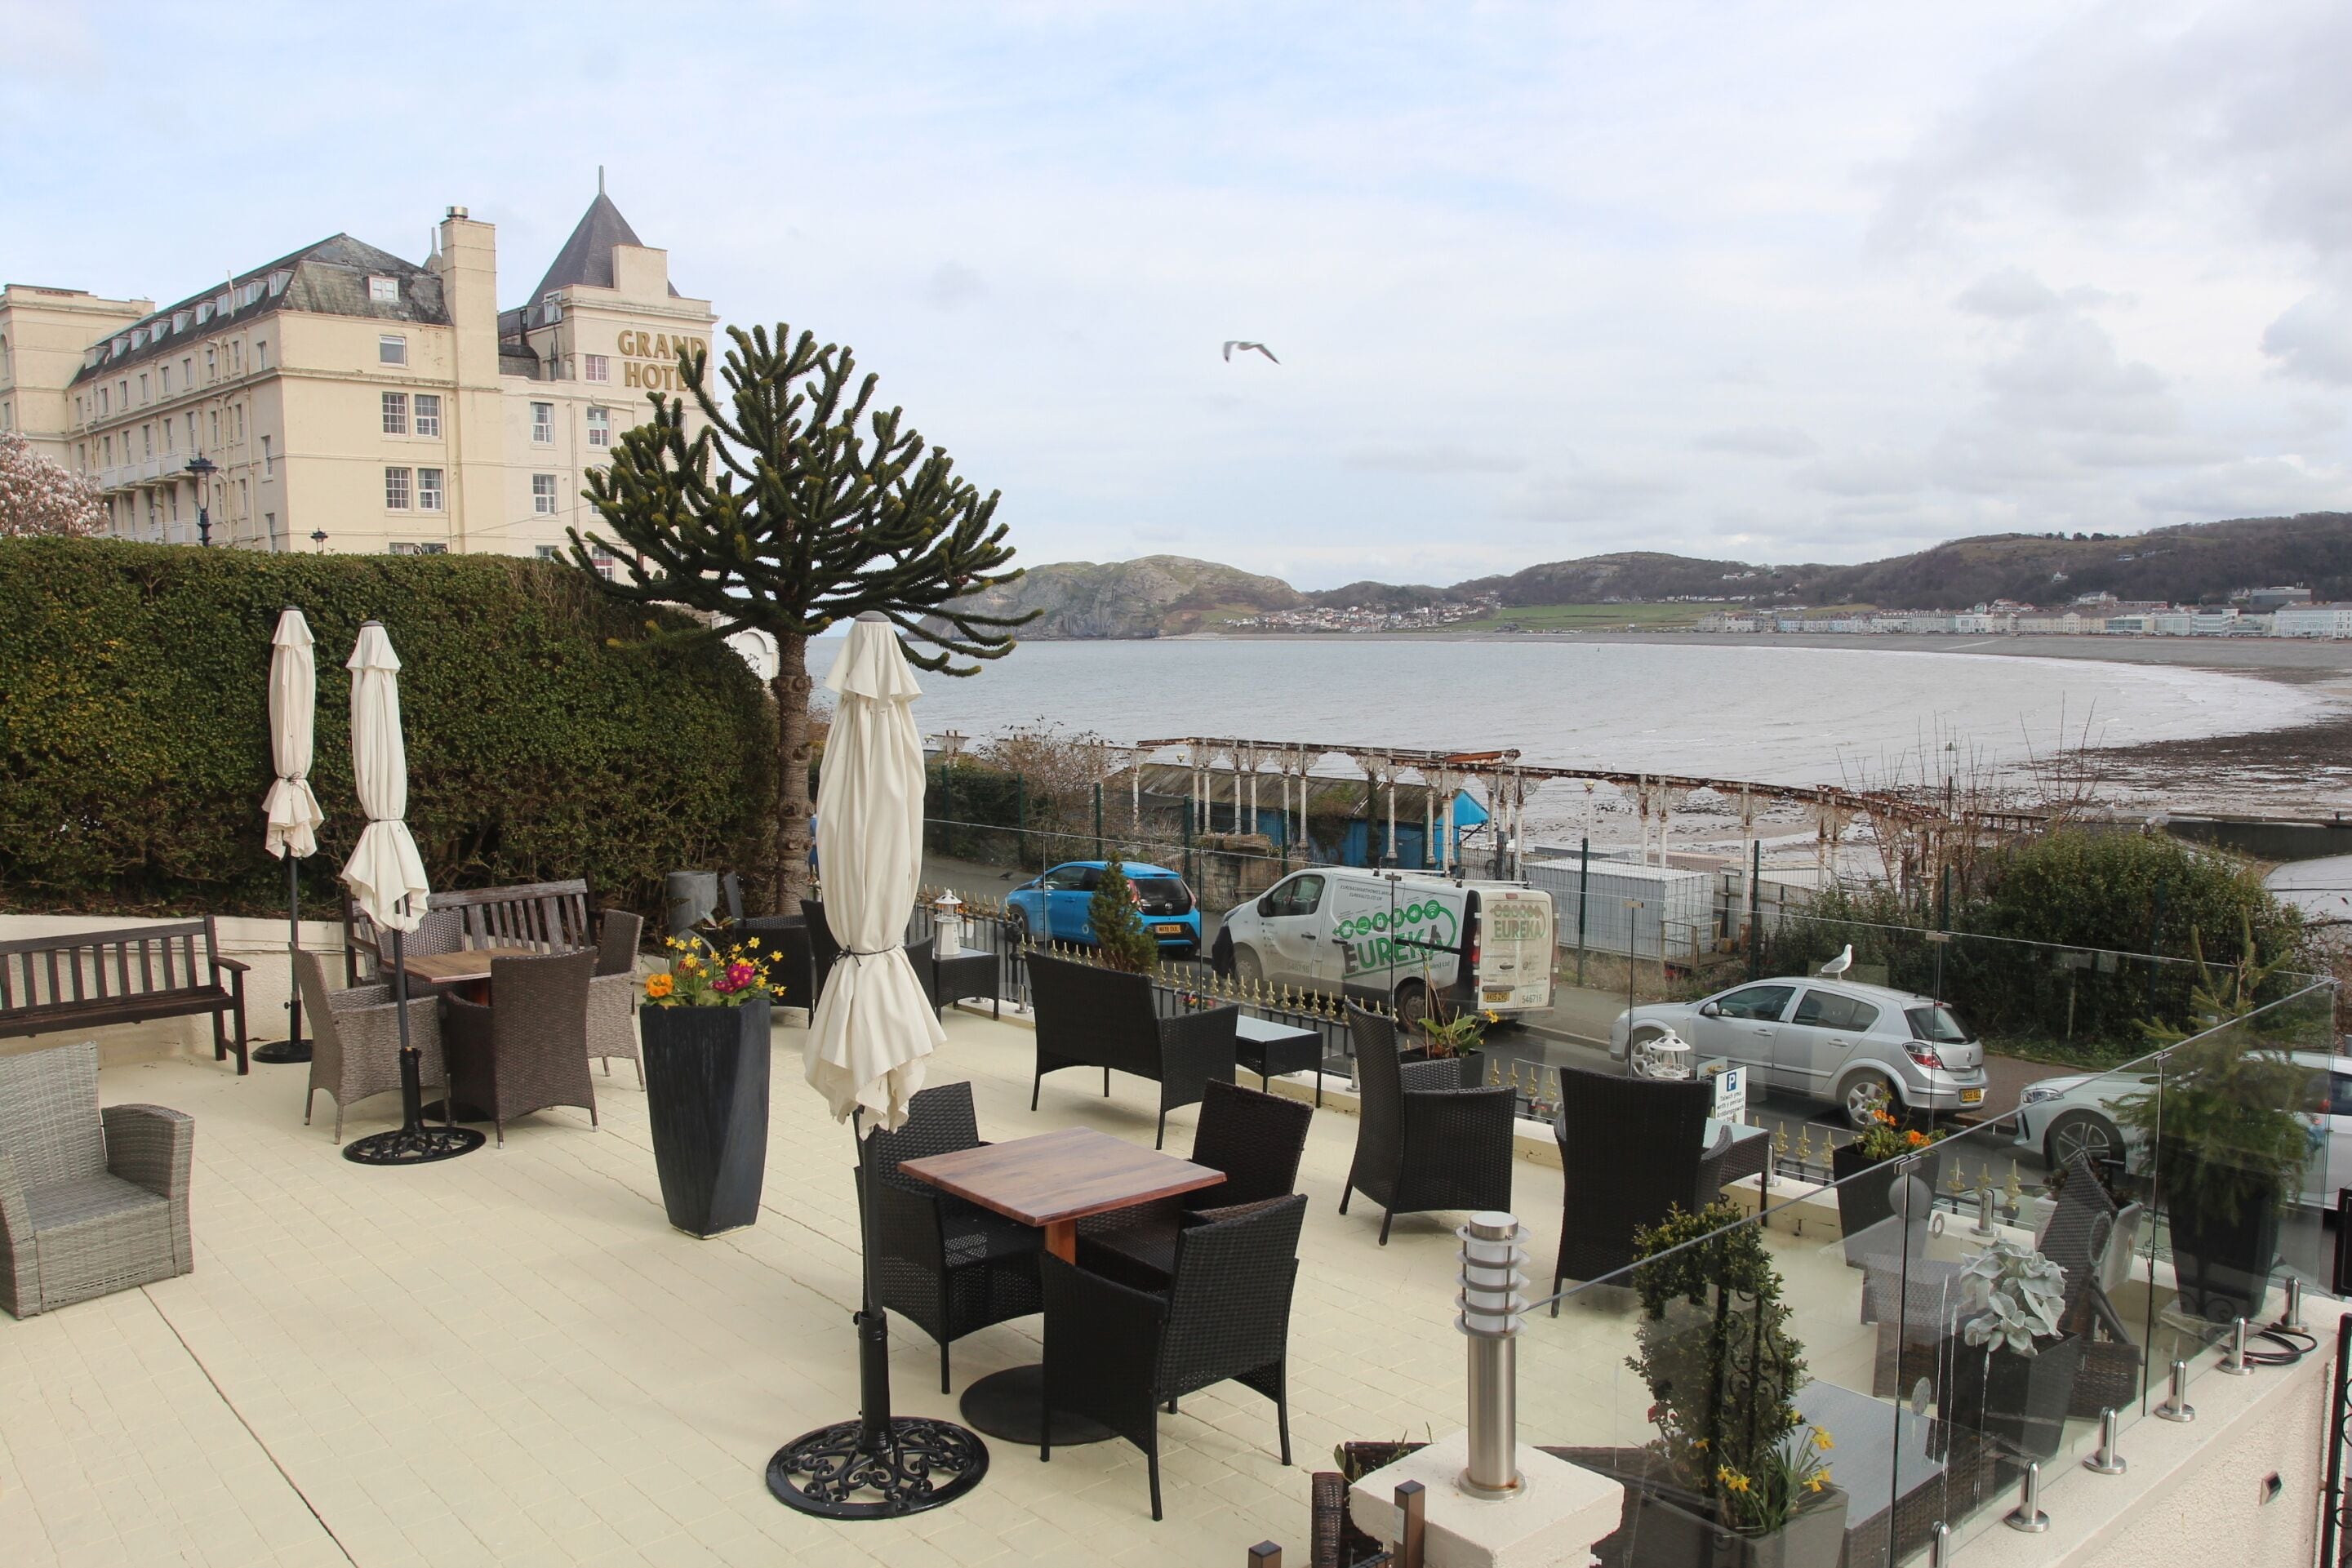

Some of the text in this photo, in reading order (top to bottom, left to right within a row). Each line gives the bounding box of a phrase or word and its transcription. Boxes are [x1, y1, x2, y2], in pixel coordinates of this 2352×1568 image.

[617, 329, 708, 362] GRAND
[624, 361, 696, 392] HOTE
[1494, 920, 1541, 939] EUREKA
[1341, 925, 1447, 974] EUREKA
[1522, 994, 1543, 1004] 546716
[1728, 1073, 1736, 1090] P
